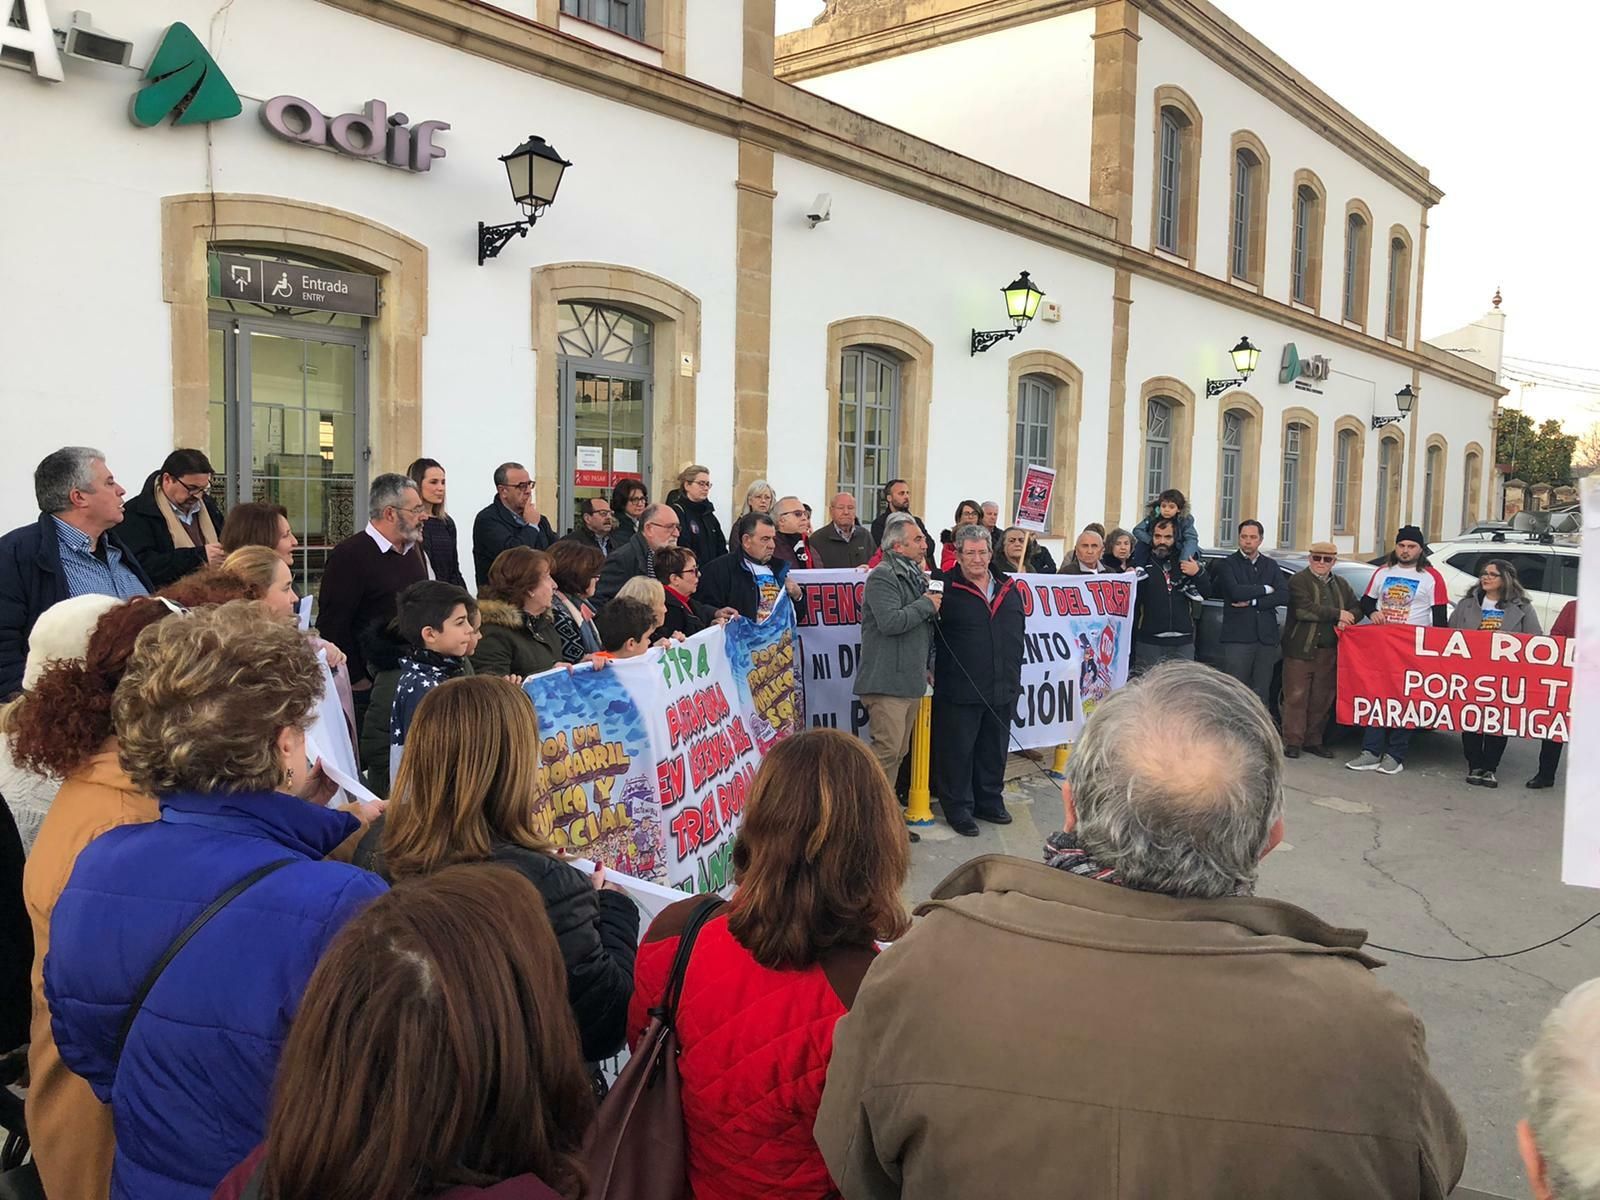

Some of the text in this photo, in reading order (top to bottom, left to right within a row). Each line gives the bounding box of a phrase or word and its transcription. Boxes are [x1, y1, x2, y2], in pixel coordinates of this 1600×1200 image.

[258, 95, 451, 172] adif
[302, 275, 349, 294] Entrada
[302, 291, 326, 303] ENTRY
[1035, 585, 1052, 616] Y
[1052, 586, 1091, 616] DEL
[1415, 625, 1472, 660] LA
[812, 653, 832, 680] NI
[1540, 678, 1573, 709] T
[1353, 696, 1454, 731] PARADA
[573, 722, 601, 747] UN
[595, 774, 616, 801] Y
[656, 753, 687, 810] EN
[549, 802, 631, 848] OCIAL
